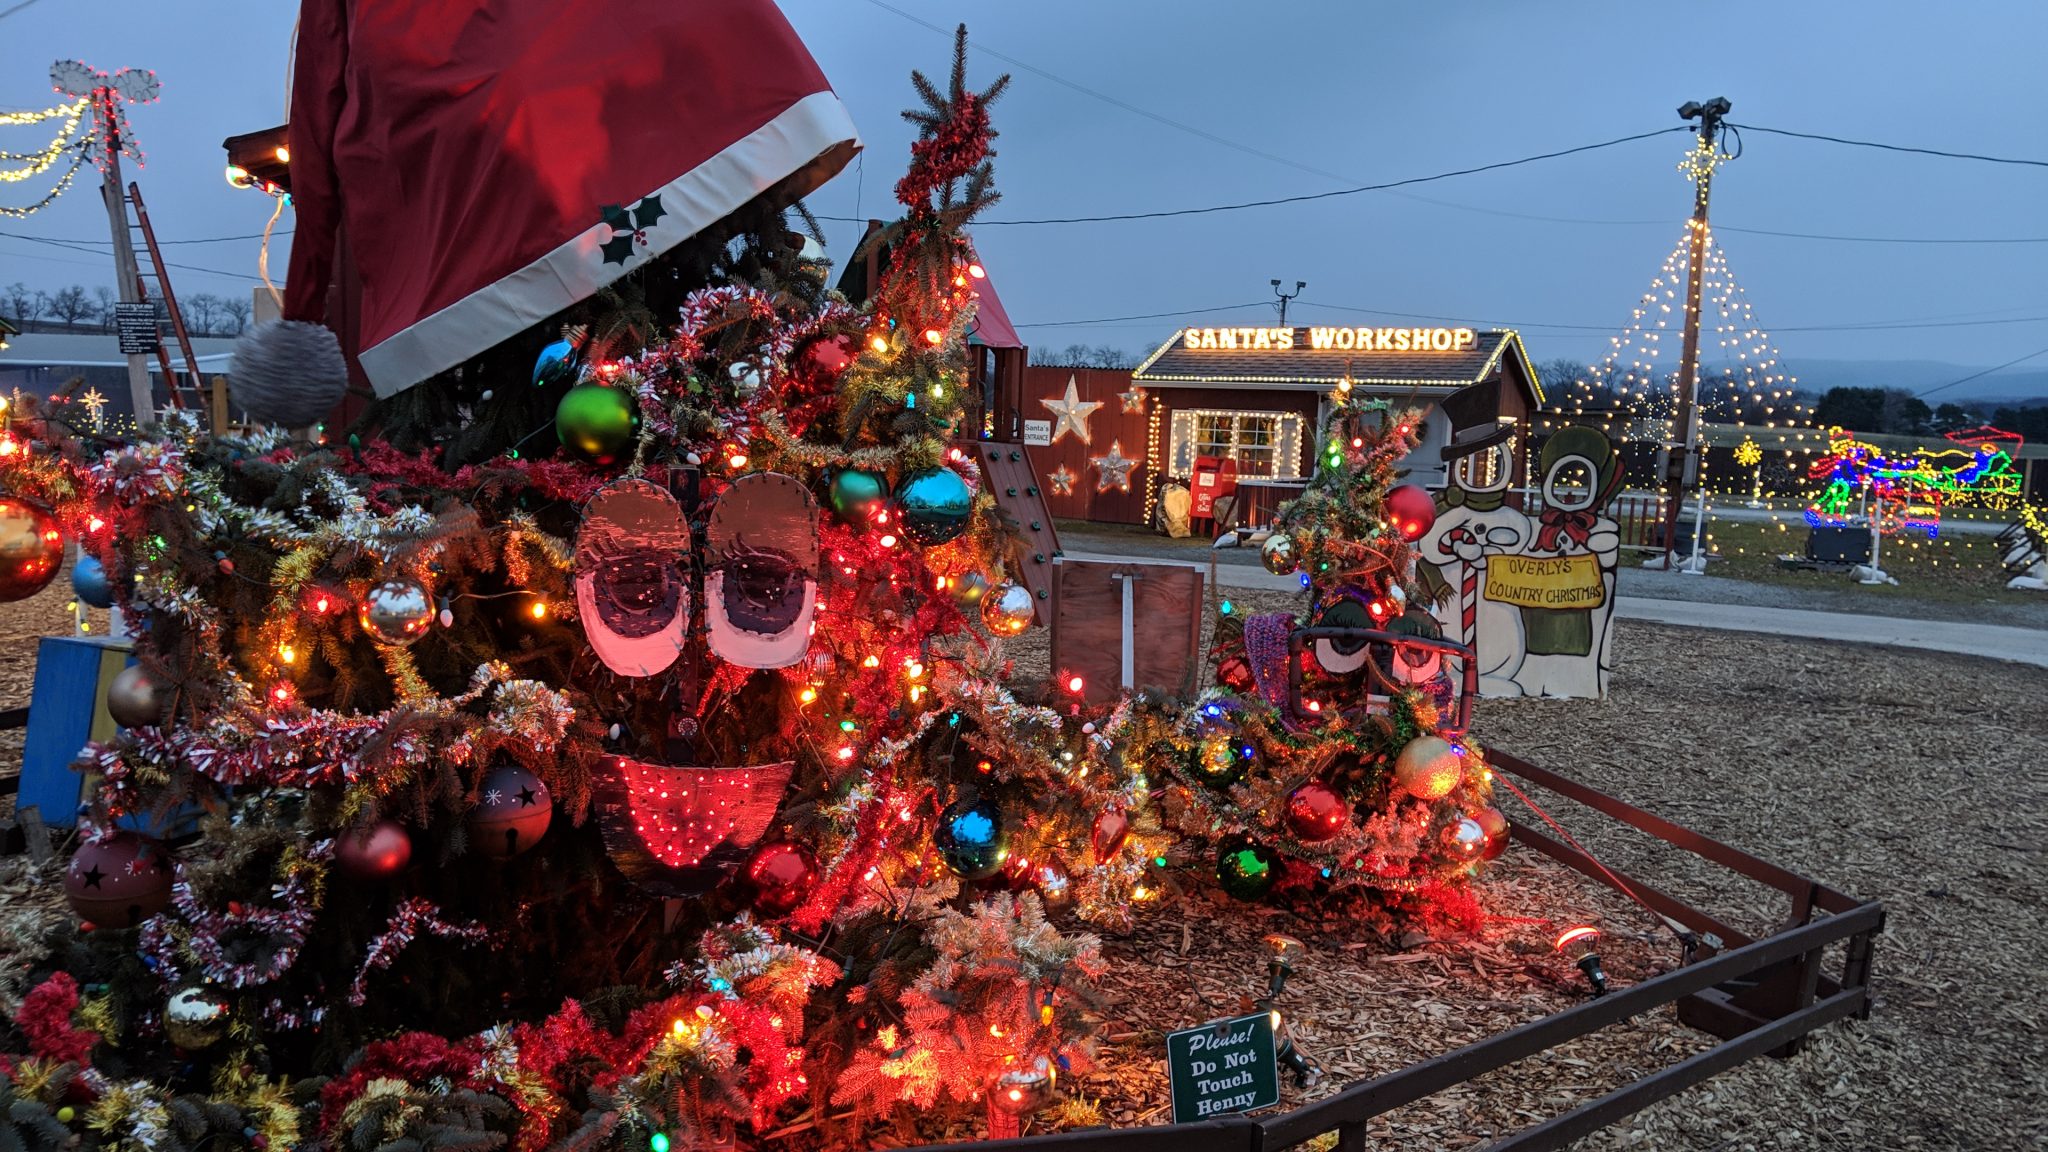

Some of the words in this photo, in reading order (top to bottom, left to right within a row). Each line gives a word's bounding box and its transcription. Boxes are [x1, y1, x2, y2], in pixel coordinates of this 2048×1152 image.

[1185, 327, 1294, 349] SANTA'S
[1310, 327, 1473, 350] WORKSHOP
[1025, 424, 1049, 432] Santa's
[1509, 558, 1572, 576] OVERLY'S
[1489, 581, 1543, 602] COUNTRY
[1546, 584, 1602, 603] CHRISTMAS
[1188, 1023, 1255, 1056] Please!
[1191, 1061, 1217, 1077] Do
[1224, 1049, 1257, 1069] Not
[1198, 1070, 1254, 1095] Touch
[1197, 1091, 1257, 1116] Henny
